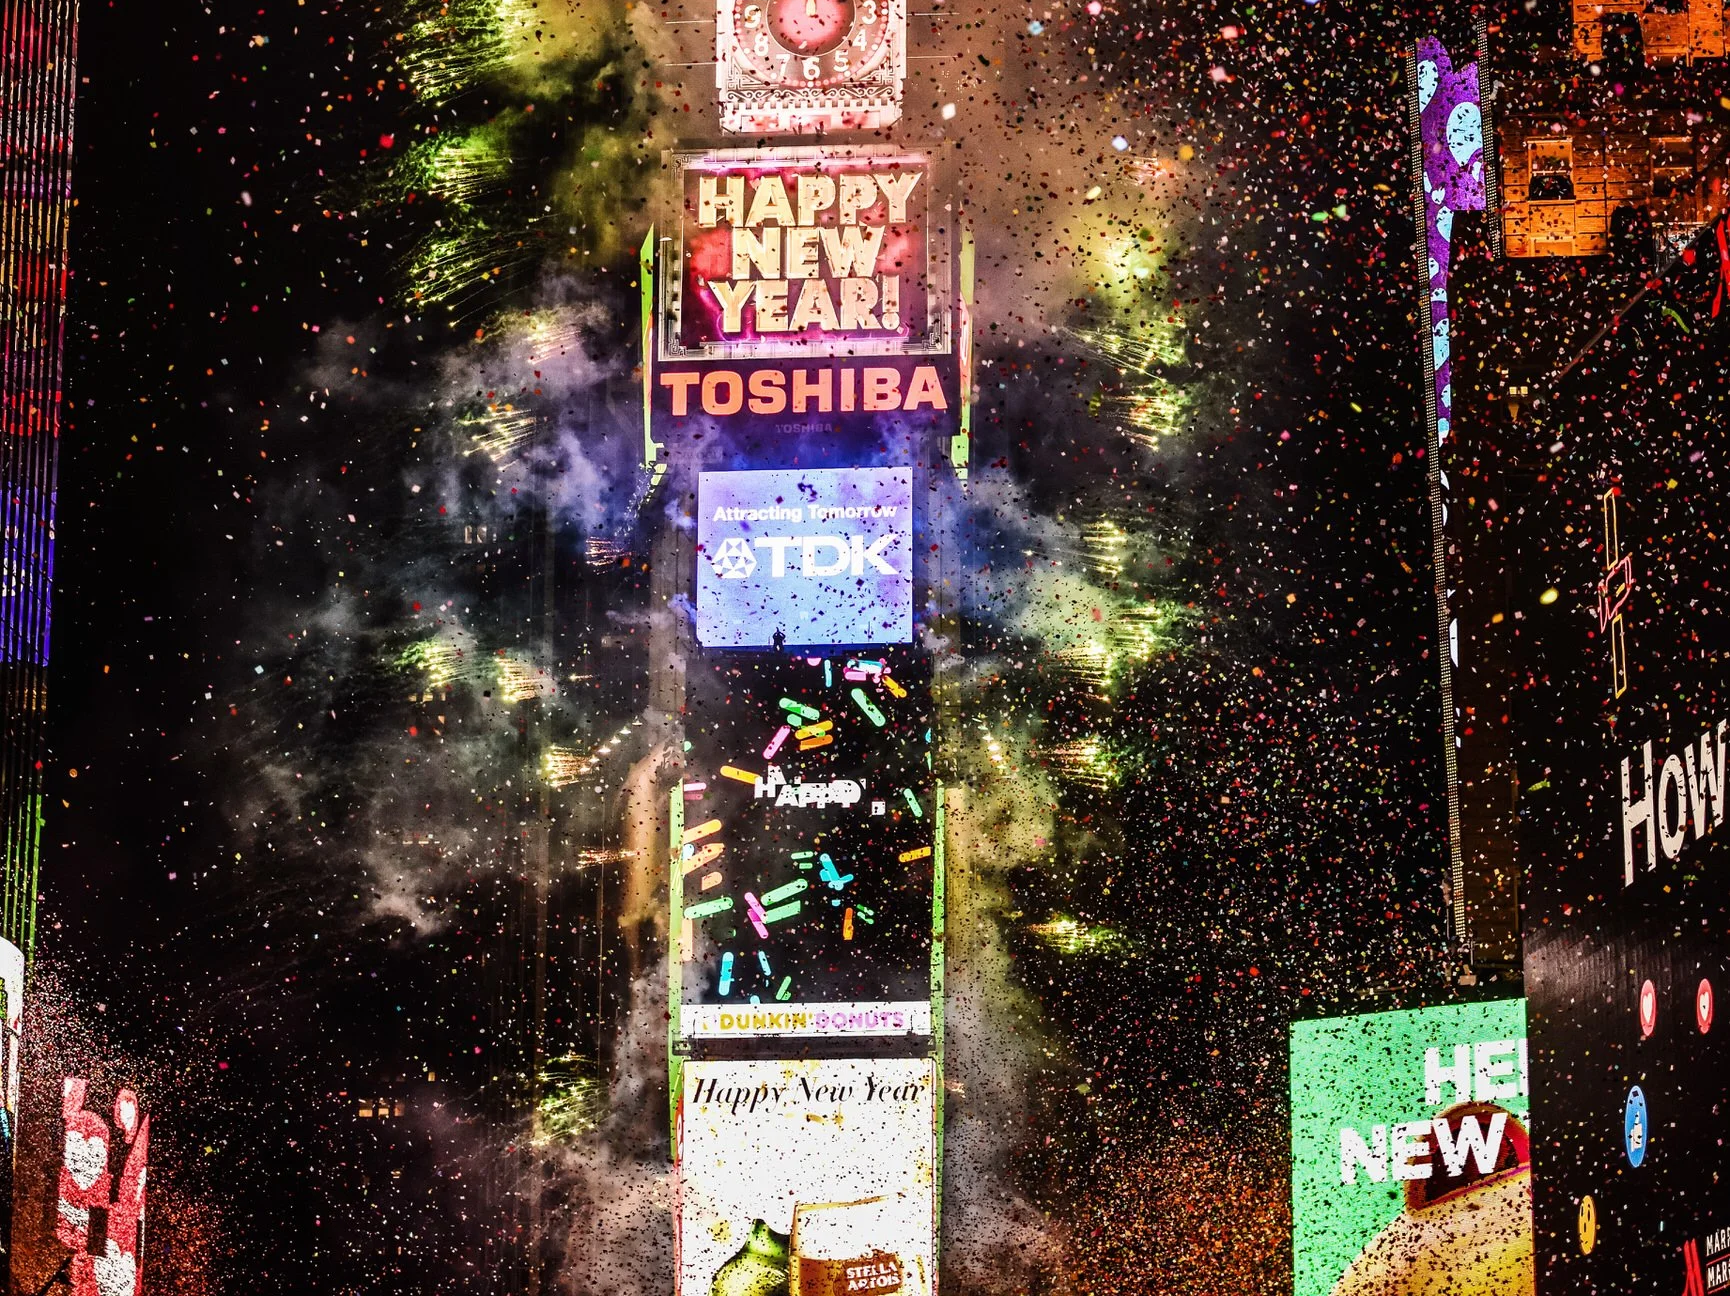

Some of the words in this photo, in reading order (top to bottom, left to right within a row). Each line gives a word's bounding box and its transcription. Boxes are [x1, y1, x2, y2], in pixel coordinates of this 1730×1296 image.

[744, 4, 762, 29] 9
[861, 0, 877, 25] 3
[753, 32, 769, 57] 8
[852, 28, 868, 52] 4
[775, 53, 791, 77] 7
[802, 56, 821, 80] 6
[833, 49, 849, 72] 5
[698, 171, 924, 229] HAPPY
[732, 224, 886, 280] NEW
[708, 274, 901, 333] YEAR!
[660, 366, 948, 416] TOSHIBA
[775, 423, 833, 434] TOSHIBA
[713, 505, 803, 523] Attracting
[807, 504, 898, 521] Tomorrow
[754, 534, 900, 578] TDK
[1620, 718, 1728, 888] HOW
[719, 1012, 813, 1031] DUNKIN'
[815, 1011, 905, 1030] DONUTS
[692, 1077, 788, 1115] Happy
[792, 1076, 853, 1104] New
[865, 1075, 926, 1104] Year
[1340, 1112, 1509, 1186] NEW
[846, 1261, 898, 1279] STELLA
[847, 1273, 901, 1292] ARTOIS
